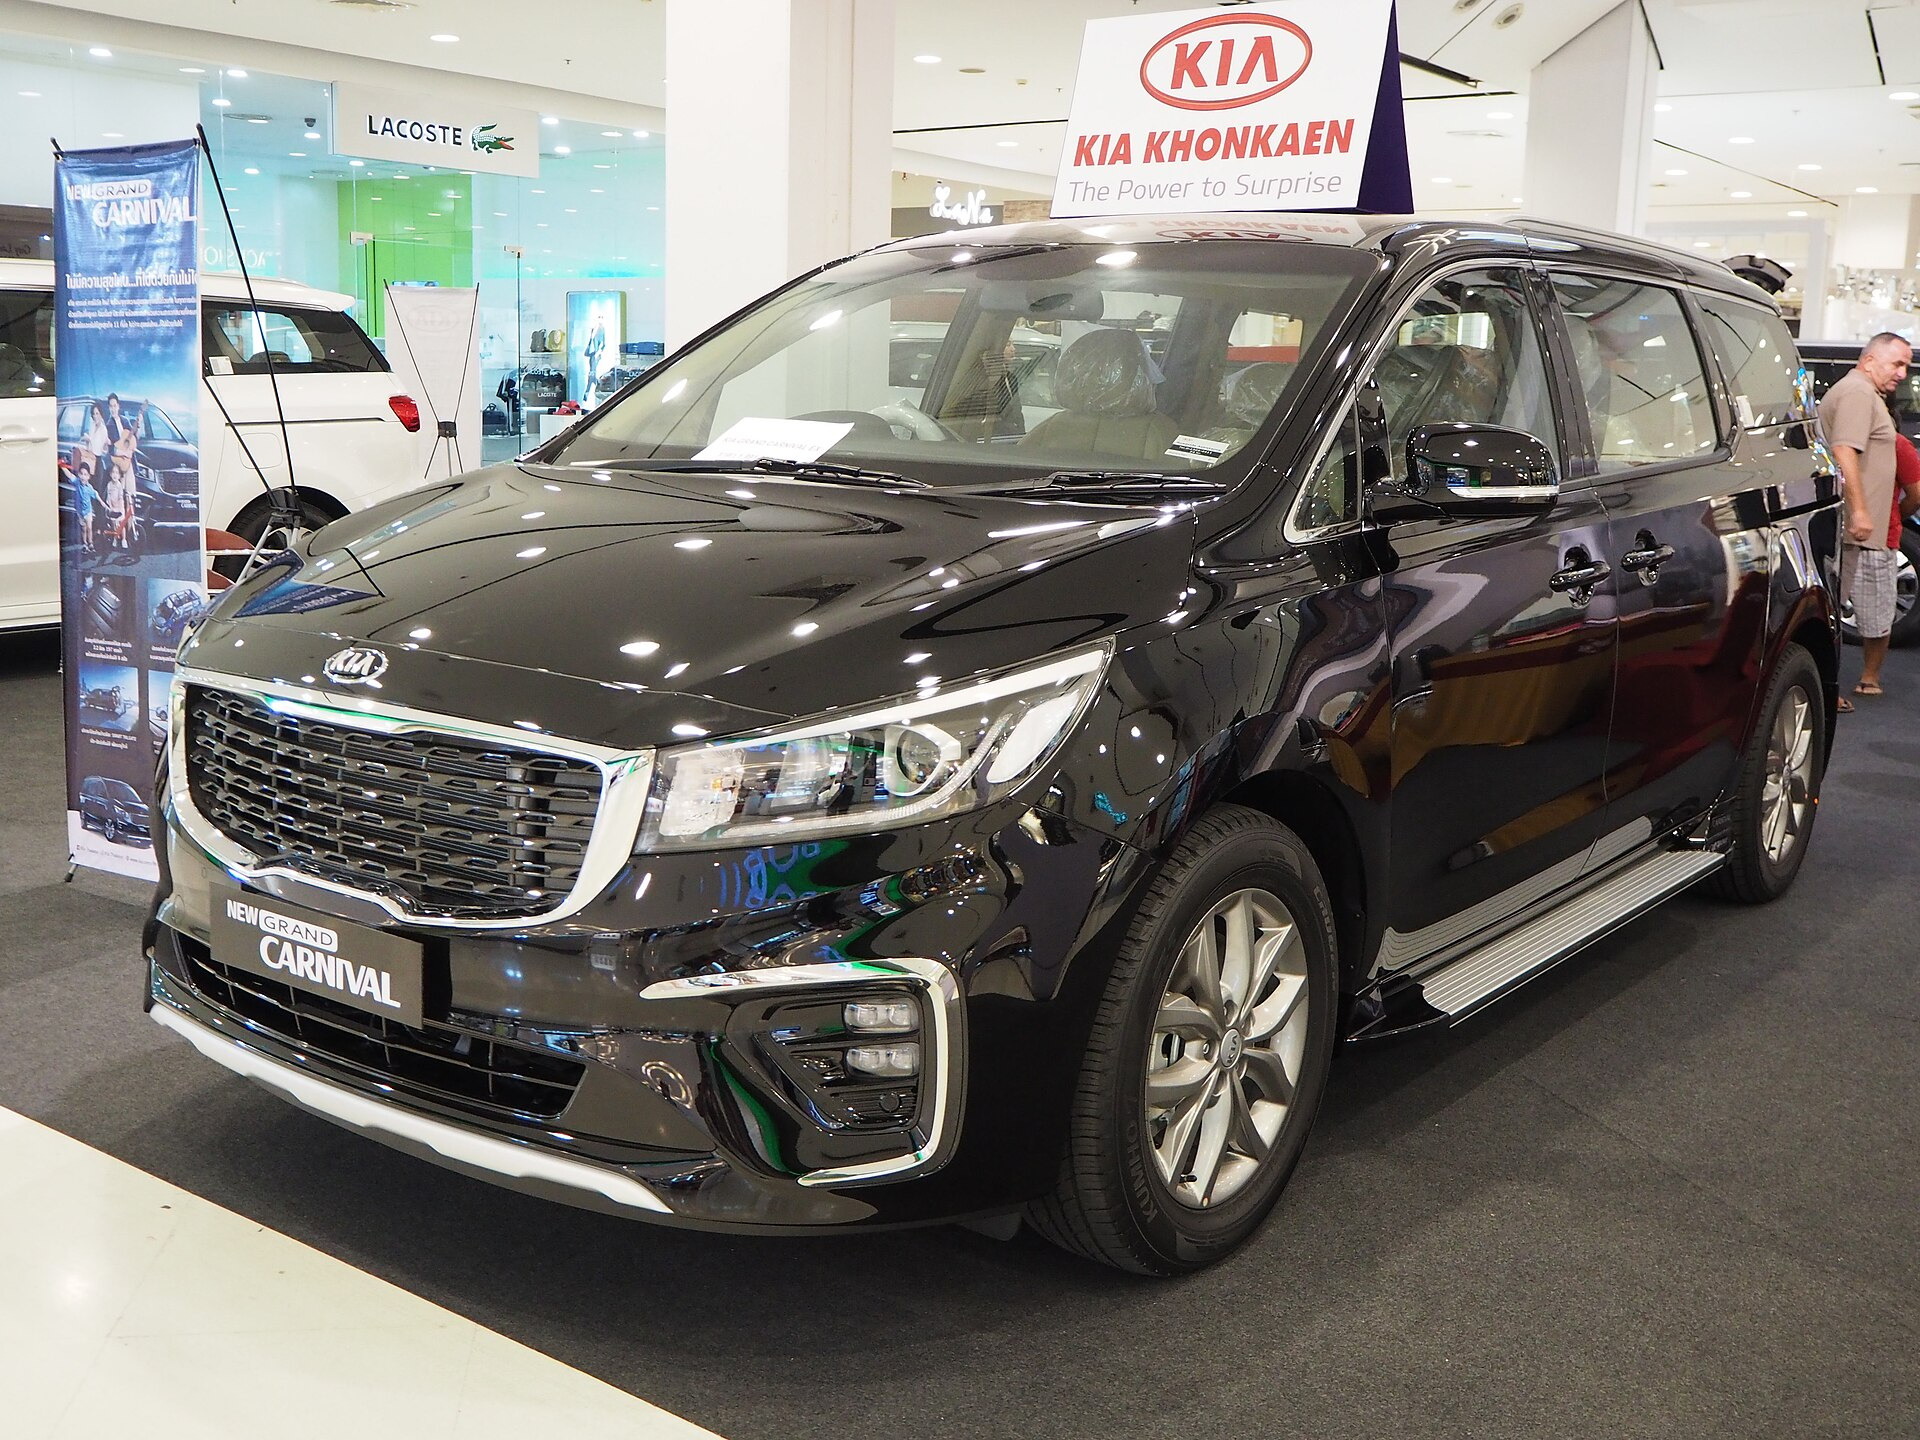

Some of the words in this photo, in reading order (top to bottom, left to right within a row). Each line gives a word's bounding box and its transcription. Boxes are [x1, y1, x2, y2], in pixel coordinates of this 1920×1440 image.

[1170, 35, 1279, 90] KIA
[367, 115, 463, 146] LACOSTE
[1073, 133, 1132, 167] KIA
[1142, 118, 1355, 164] KHONKAEN
[66, 184, 92, 200] NEW
[95, 183, 148, 197] GRAND
[1069, 180, 1110, 203] The
[1117, 178, 1194, 200] Power
[1202, 178, 1226, 197] to
[1235, 171, 1342, 200] Surprise
[92, 196, 197, 228] CARNIVAL
[329, 650, 376, 676] KIA
[226, 899, 260, 926] NEW
[263, 915, 333, 947] GRAND
[259, 935, 401, 1008] CARNIVAL
[1225, 1034, 1238, 1064] KIA
[1126, 1119, 1158, 1224] KUMHO
